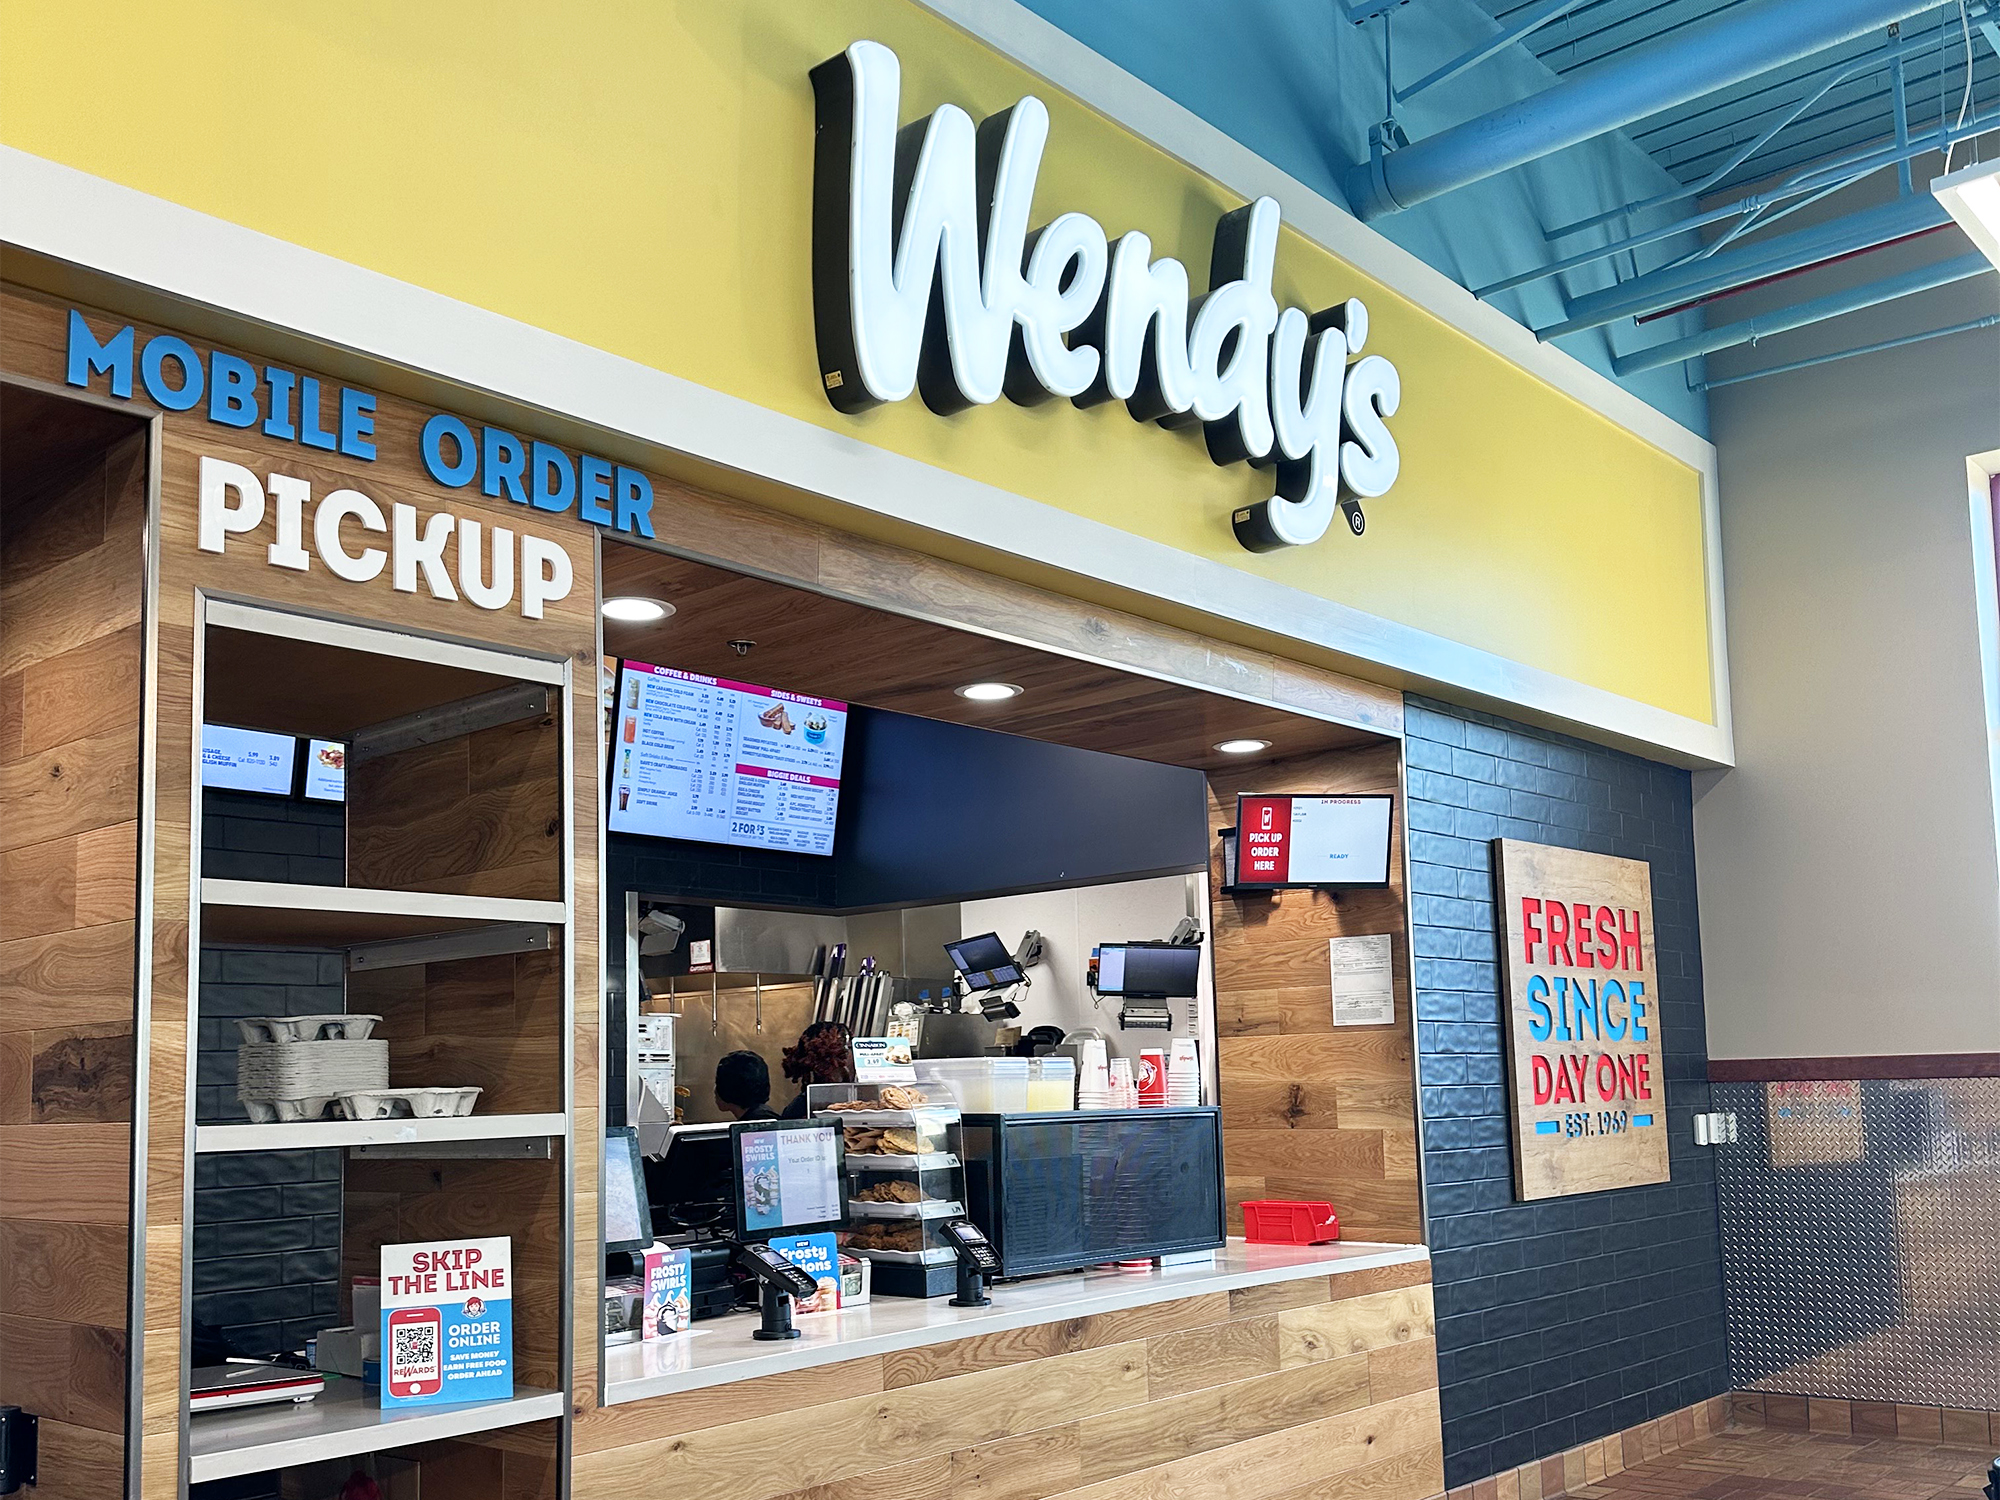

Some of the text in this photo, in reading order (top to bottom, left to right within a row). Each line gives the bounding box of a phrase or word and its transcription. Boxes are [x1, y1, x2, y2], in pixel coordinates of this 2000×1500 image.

[840, 39, 1401, 546] Wendy's
[65, 308, 655, 539] MOBILE ORDER
[198, 455, 574, 619] PICKUP
[654, 666, 717, 686] COFFEE & DRINKS
[771, 690, 790, 700] SIDES
[796, 695, 823, 707] SWEETS
[767, 770, 811, 783] BIGGIE DEALS
[732, 822, 765, 835] 2 FOR $3
[1249, 833, 1282, 843] PICK UP
[1251, 846, 1279, 857] ORDER
[1254, 860, 1275, 871] HERE
[1522, 897, 1644, 972] FRESH
[1527, 975, 1648, 1042] SINCE
[1531, 1053, 1653, 1106] DAY ONE
[1565, 1110, 1628, 1138] EST. 1969
[780, 1132, 832, 1145] THANK YOU
[744, 1144, 774, 1154] FROSTY
[745, 1152, 775, 1162] SWIRLS
[412, 1248, 482, 1273] SKIP
[661, 1254, 676, 1263] NEW
[779, 1245, 828, 1261] Frosty
[650, 1263, 686, 1280] FROSTY
[388, 1268, 505, 1296] THE LINE
[650, 1275, 687, 1293] SWIRLS
[448, 1321, 501, 1337] ORDER
[448, 1333, 501, 1348] ONLINE
[450, 1351, 500, 1361] SAVE MONEY
[465, 1361, 483, 1369] FREE
[484, 1359, 507, 1367] FOOD
[447, 1369, 503, 1380] ORDER AHEAD
